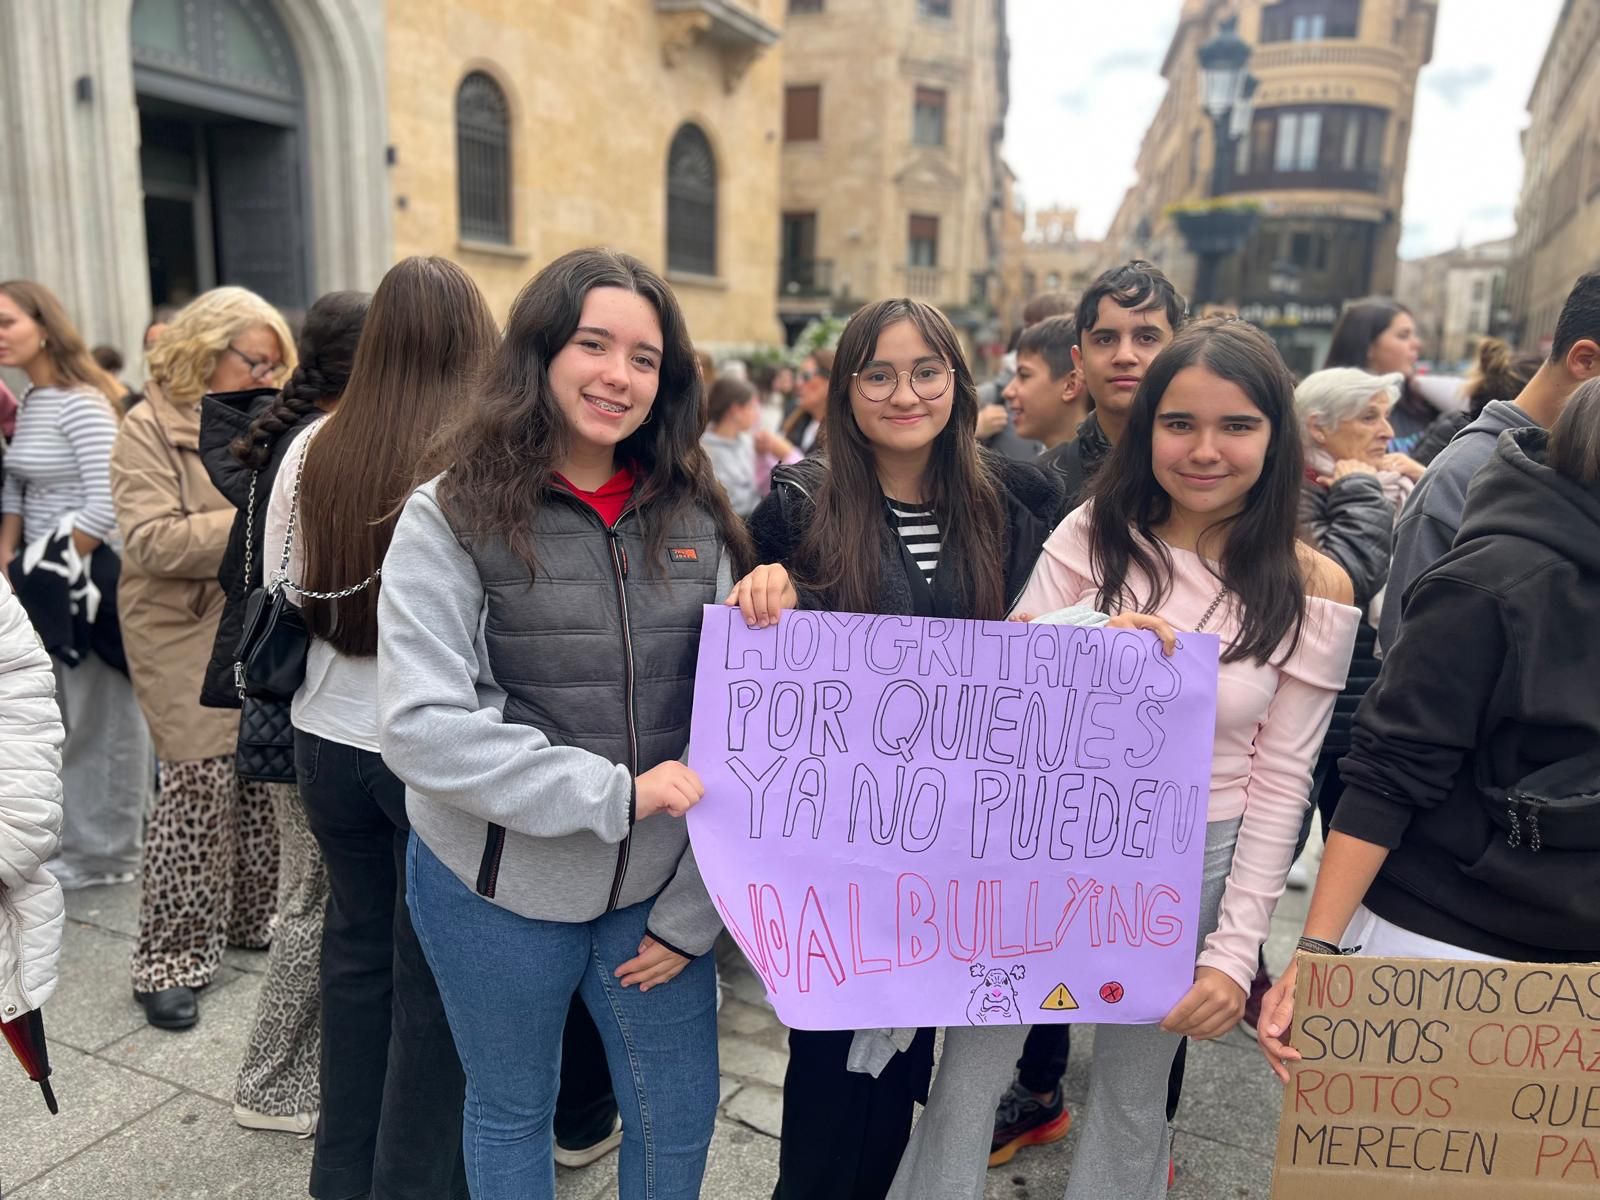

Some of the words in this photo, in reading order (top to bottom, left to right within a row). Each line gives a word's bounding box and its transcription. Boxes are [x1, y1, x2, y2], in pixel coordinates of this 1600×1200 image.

[727, 680, 852, 756] POR
[873, 680, 1166, 773] QUIENES
[726, 756, 826, 838] YA
[848, 763, 945, 852] NO
[971, 769, 1198, 860] PUEDEN
[1308, 962, 1355, 1009] NO
[1368, 965, 1507, 1013] SOMOS
[1301, 1015, 1449, 1063] SOMOS
[1295, 1069, 1458, 1118] ROTOS
[1512, 1083, 1600, 1128] QUE
[1293, 1124, 1497, 1175] MERECEN
[1535, 1135, 1600, 1179] PA
